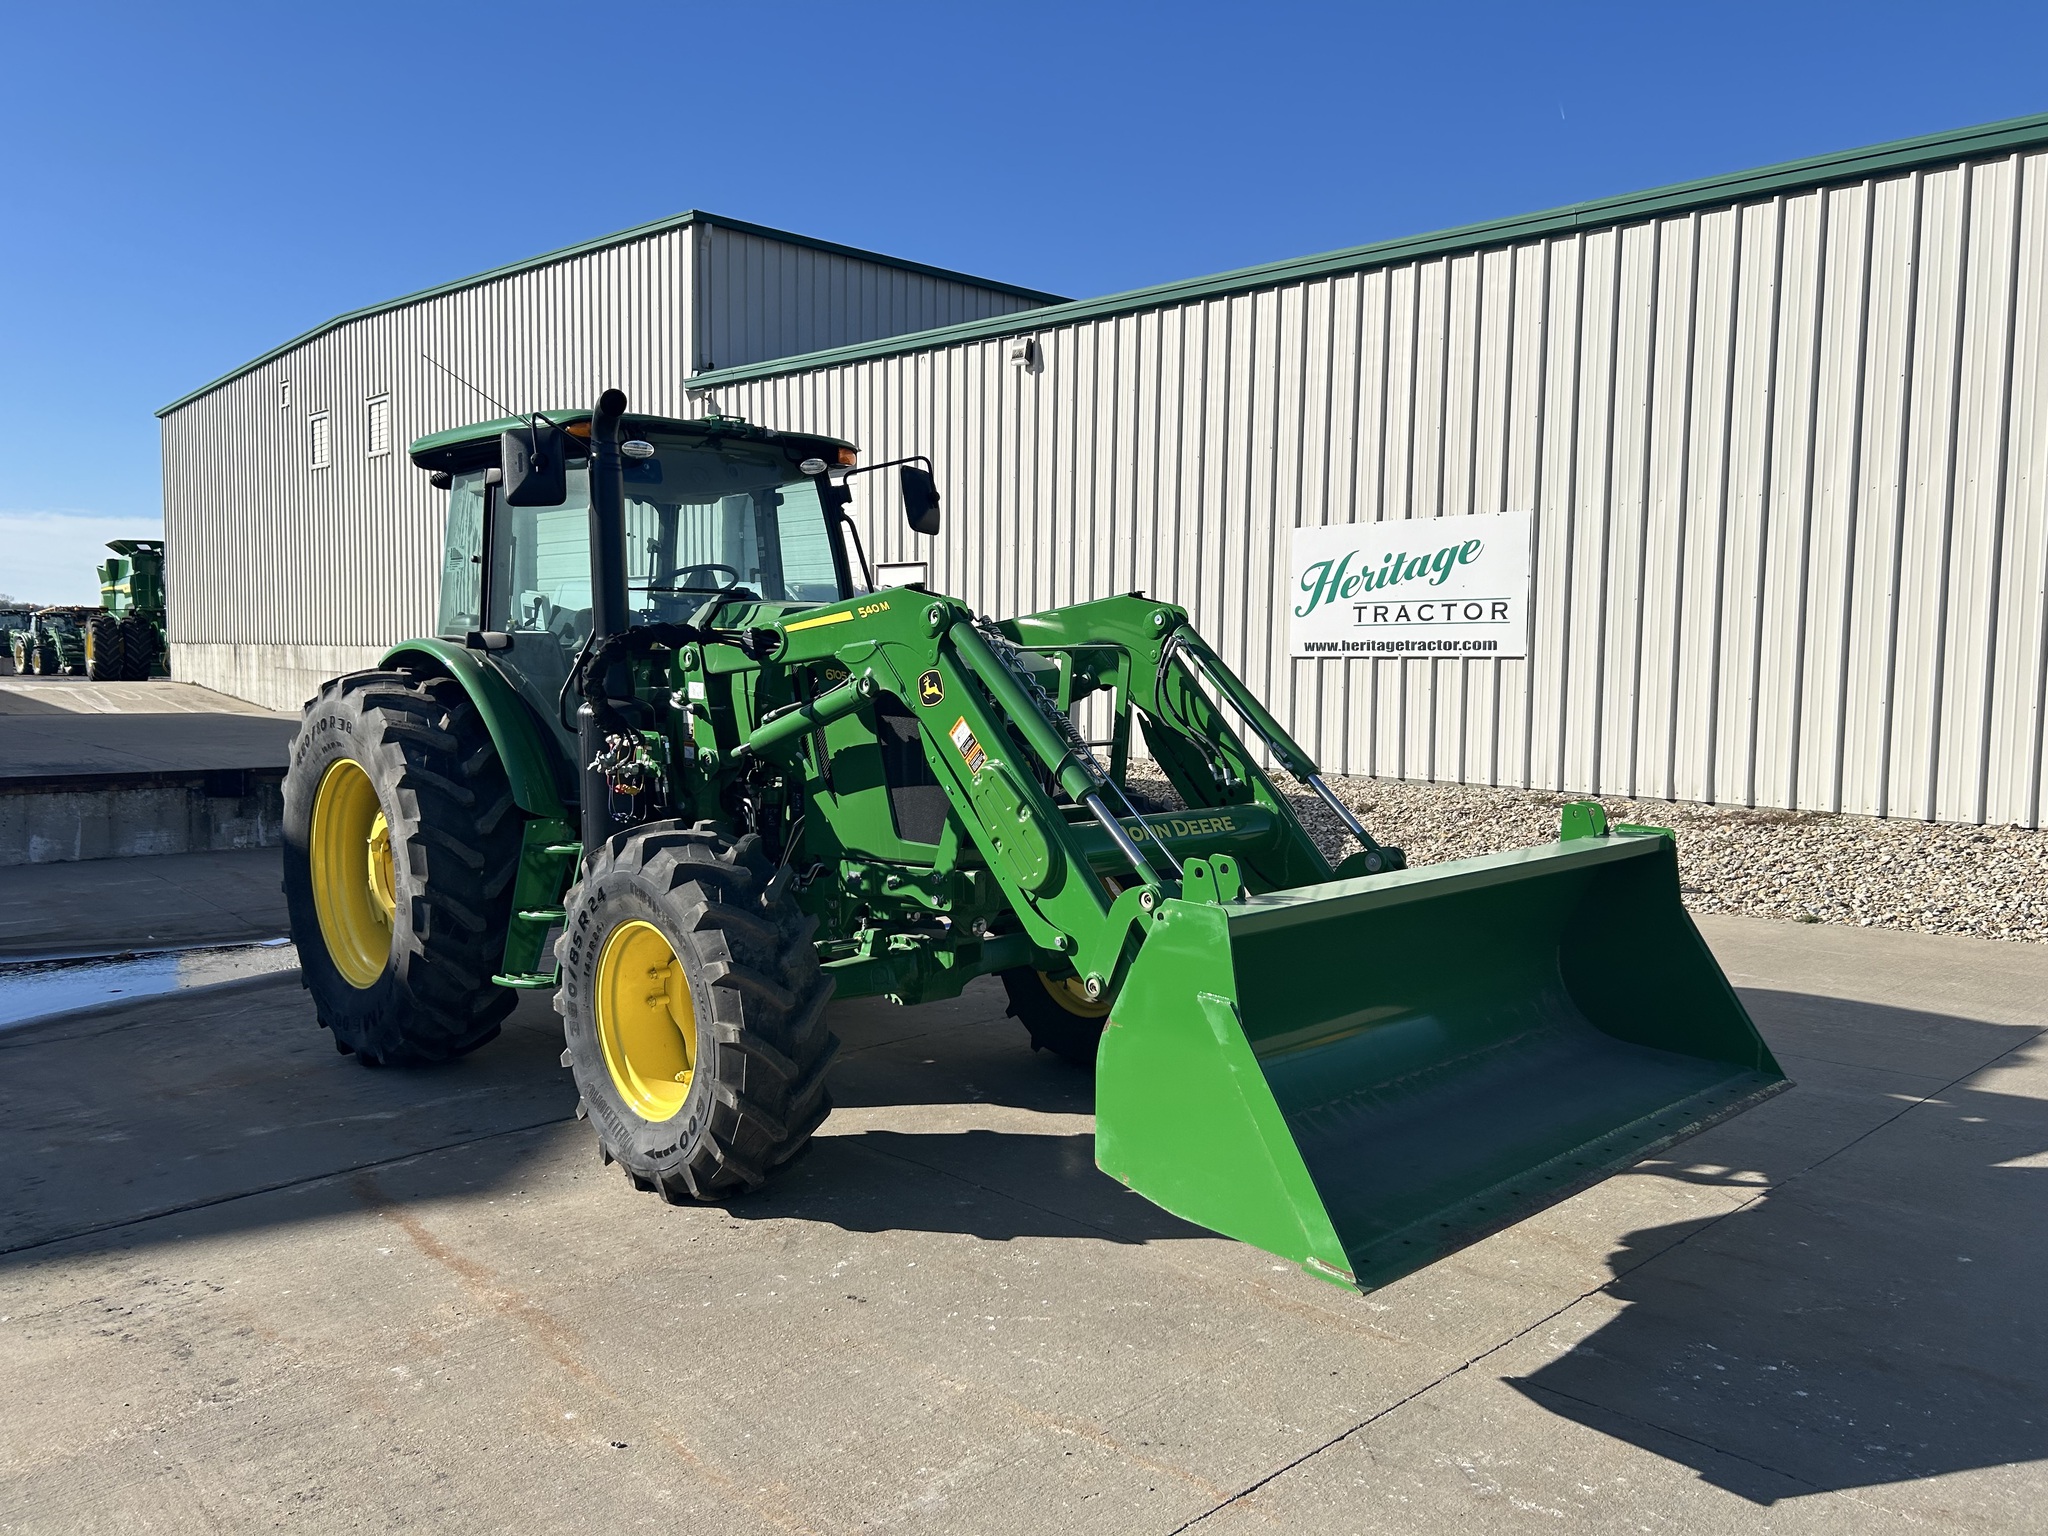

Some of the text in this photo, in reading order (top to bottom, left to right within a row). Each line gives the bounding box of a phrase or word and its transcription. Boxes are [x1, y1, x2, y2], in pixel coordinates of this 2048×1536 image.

[1294, 539, 1485, 618] Heritage
[1352, 602, 1509, 623] TRACTOR
[1304, 639, 1498, 653] www.heritagetractor.com
[1170, 816, 1236, 837] DEERE
